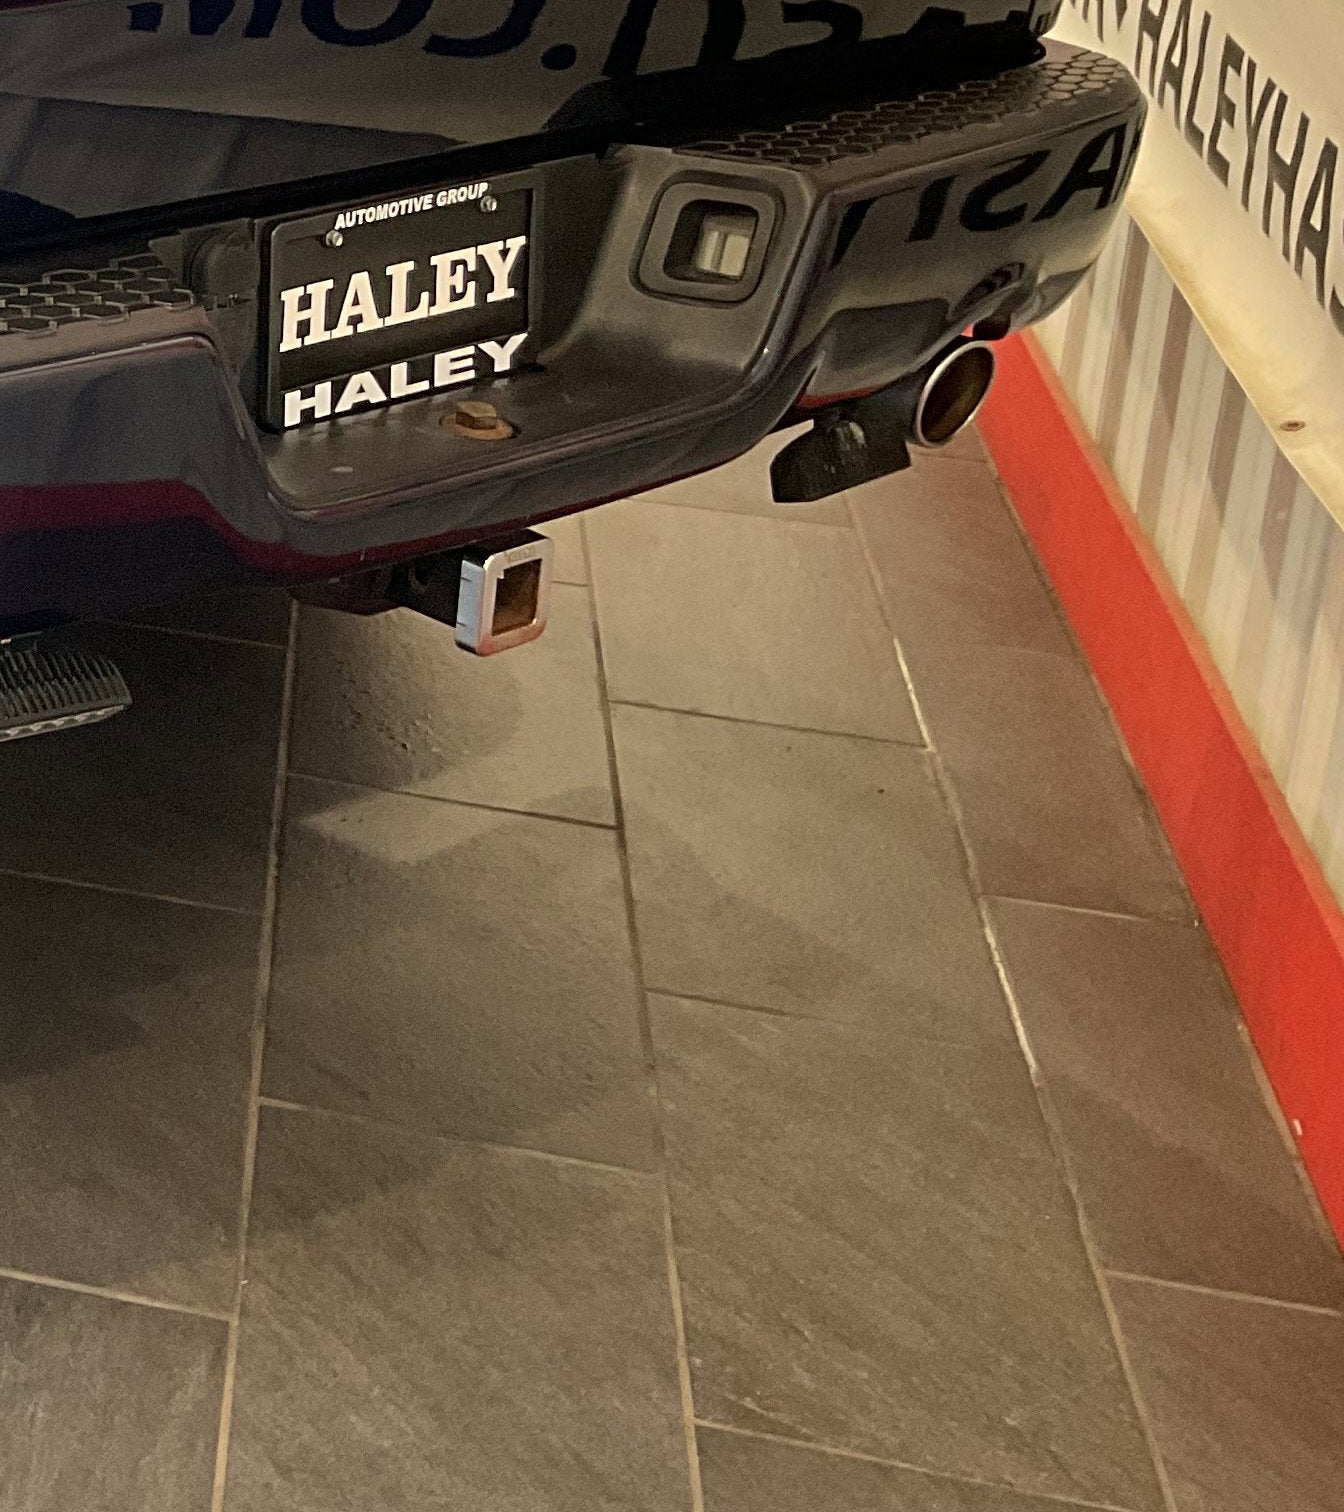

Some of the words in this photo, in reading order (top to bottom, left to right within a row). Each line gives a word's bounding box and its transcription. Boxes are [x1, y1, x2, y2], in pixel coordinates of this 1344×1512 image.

[334, 193, 433, 230] AUTOMOTIVE
[435, 182, 489, 207] GROUP
[279, 235, 527, 352] HALEY
[284, 333, 529, 428] HALEY
